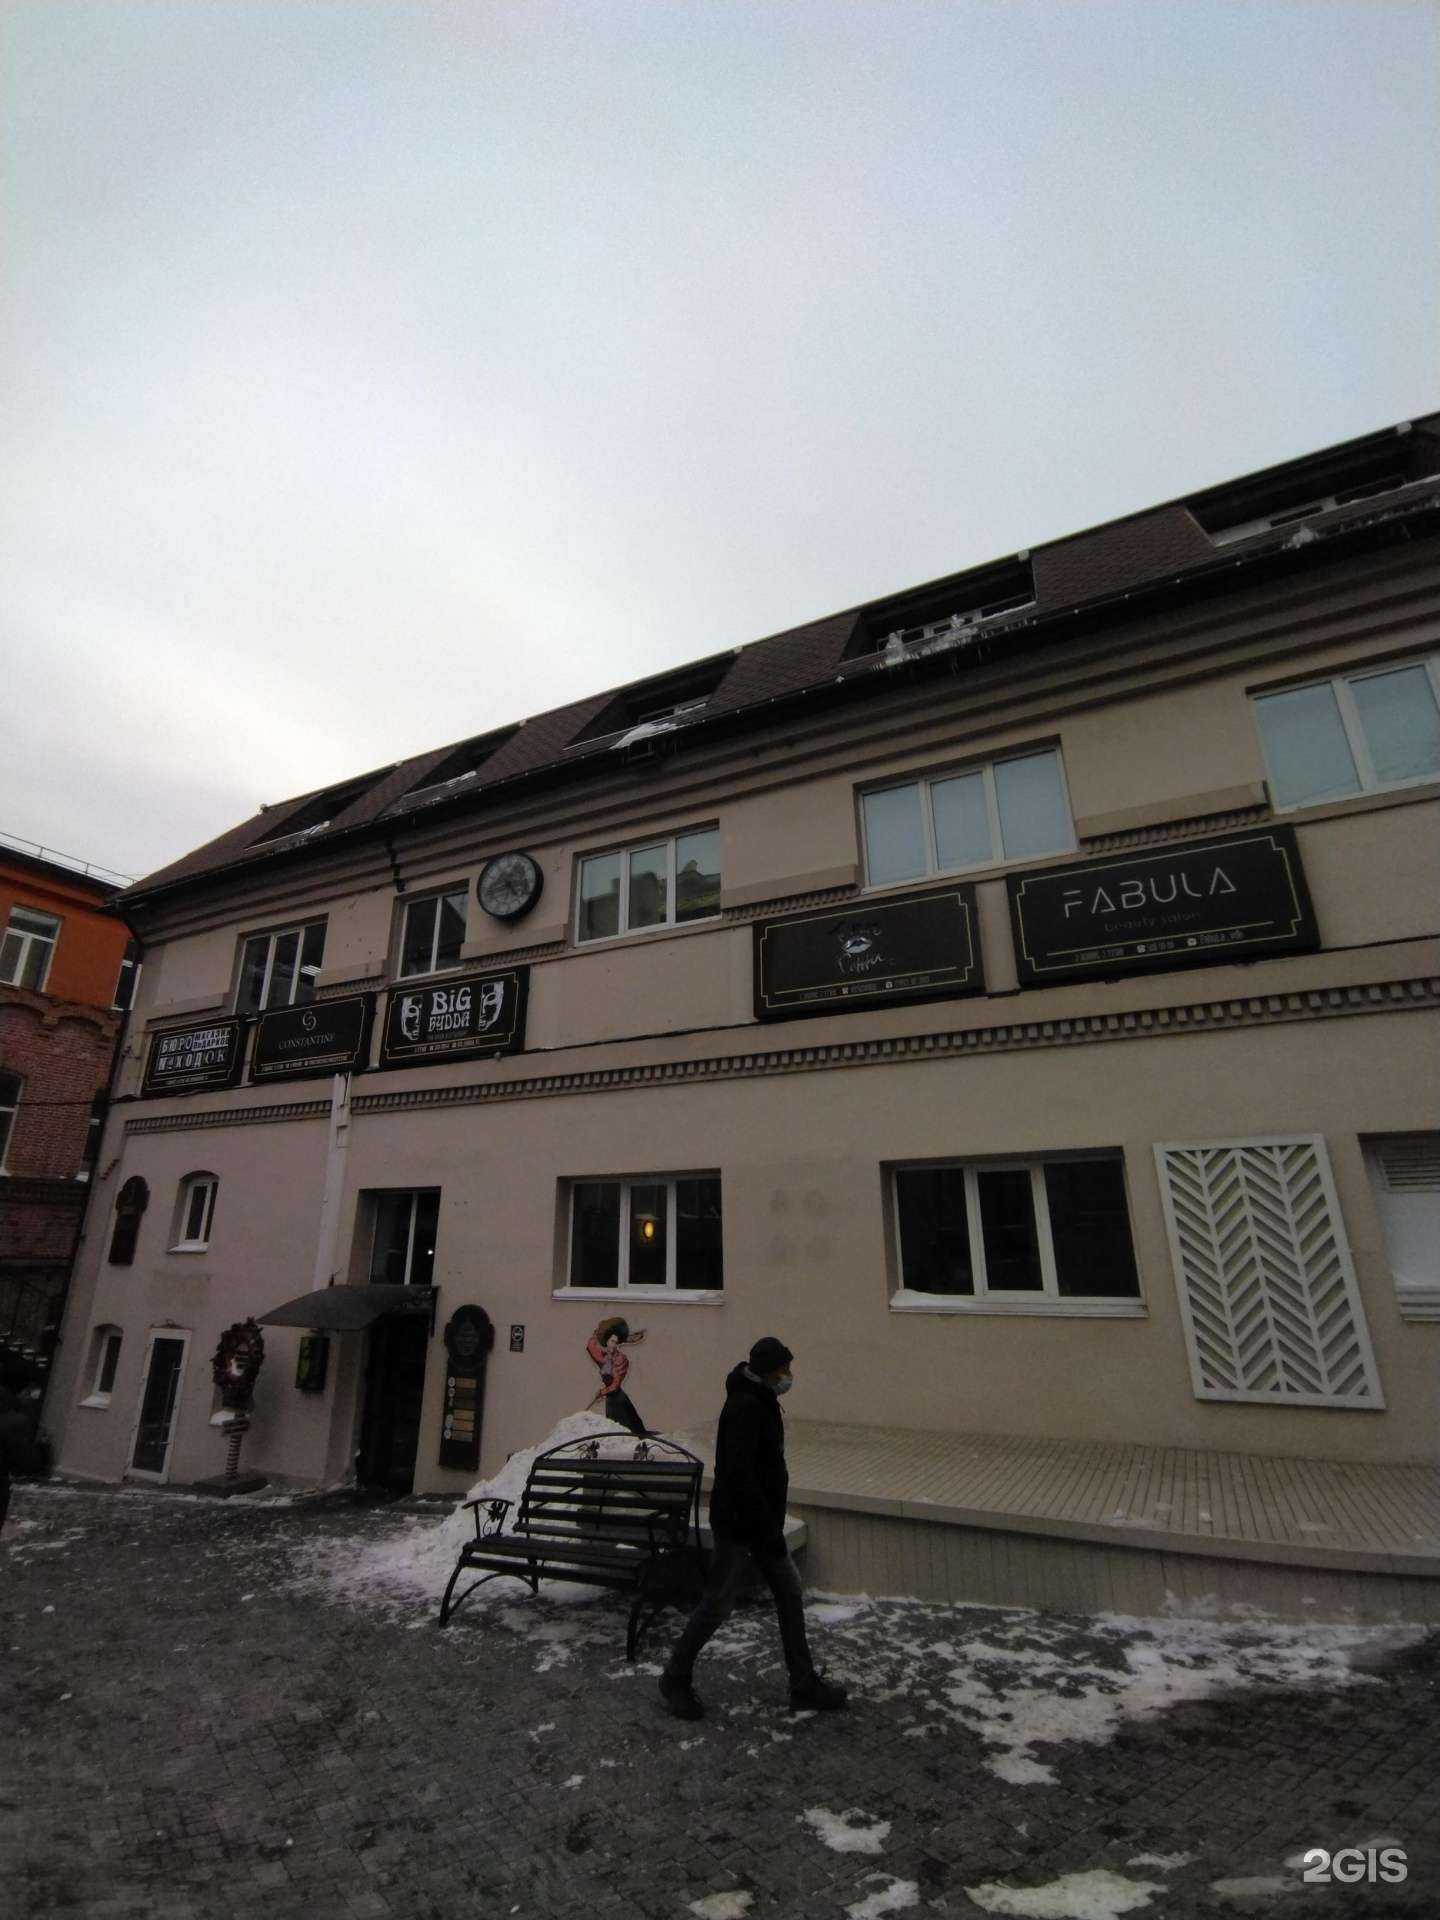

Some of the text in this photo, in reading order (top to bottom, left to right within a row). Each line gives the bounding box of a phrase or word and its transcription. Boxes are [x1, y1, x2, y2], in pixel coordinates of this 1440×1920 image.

[1062, 866, 1238, 919] FABULA
[160, 1035, 193, 1055] БЮРО
[278, 1032, 335, 1050] CONSTANTINE
